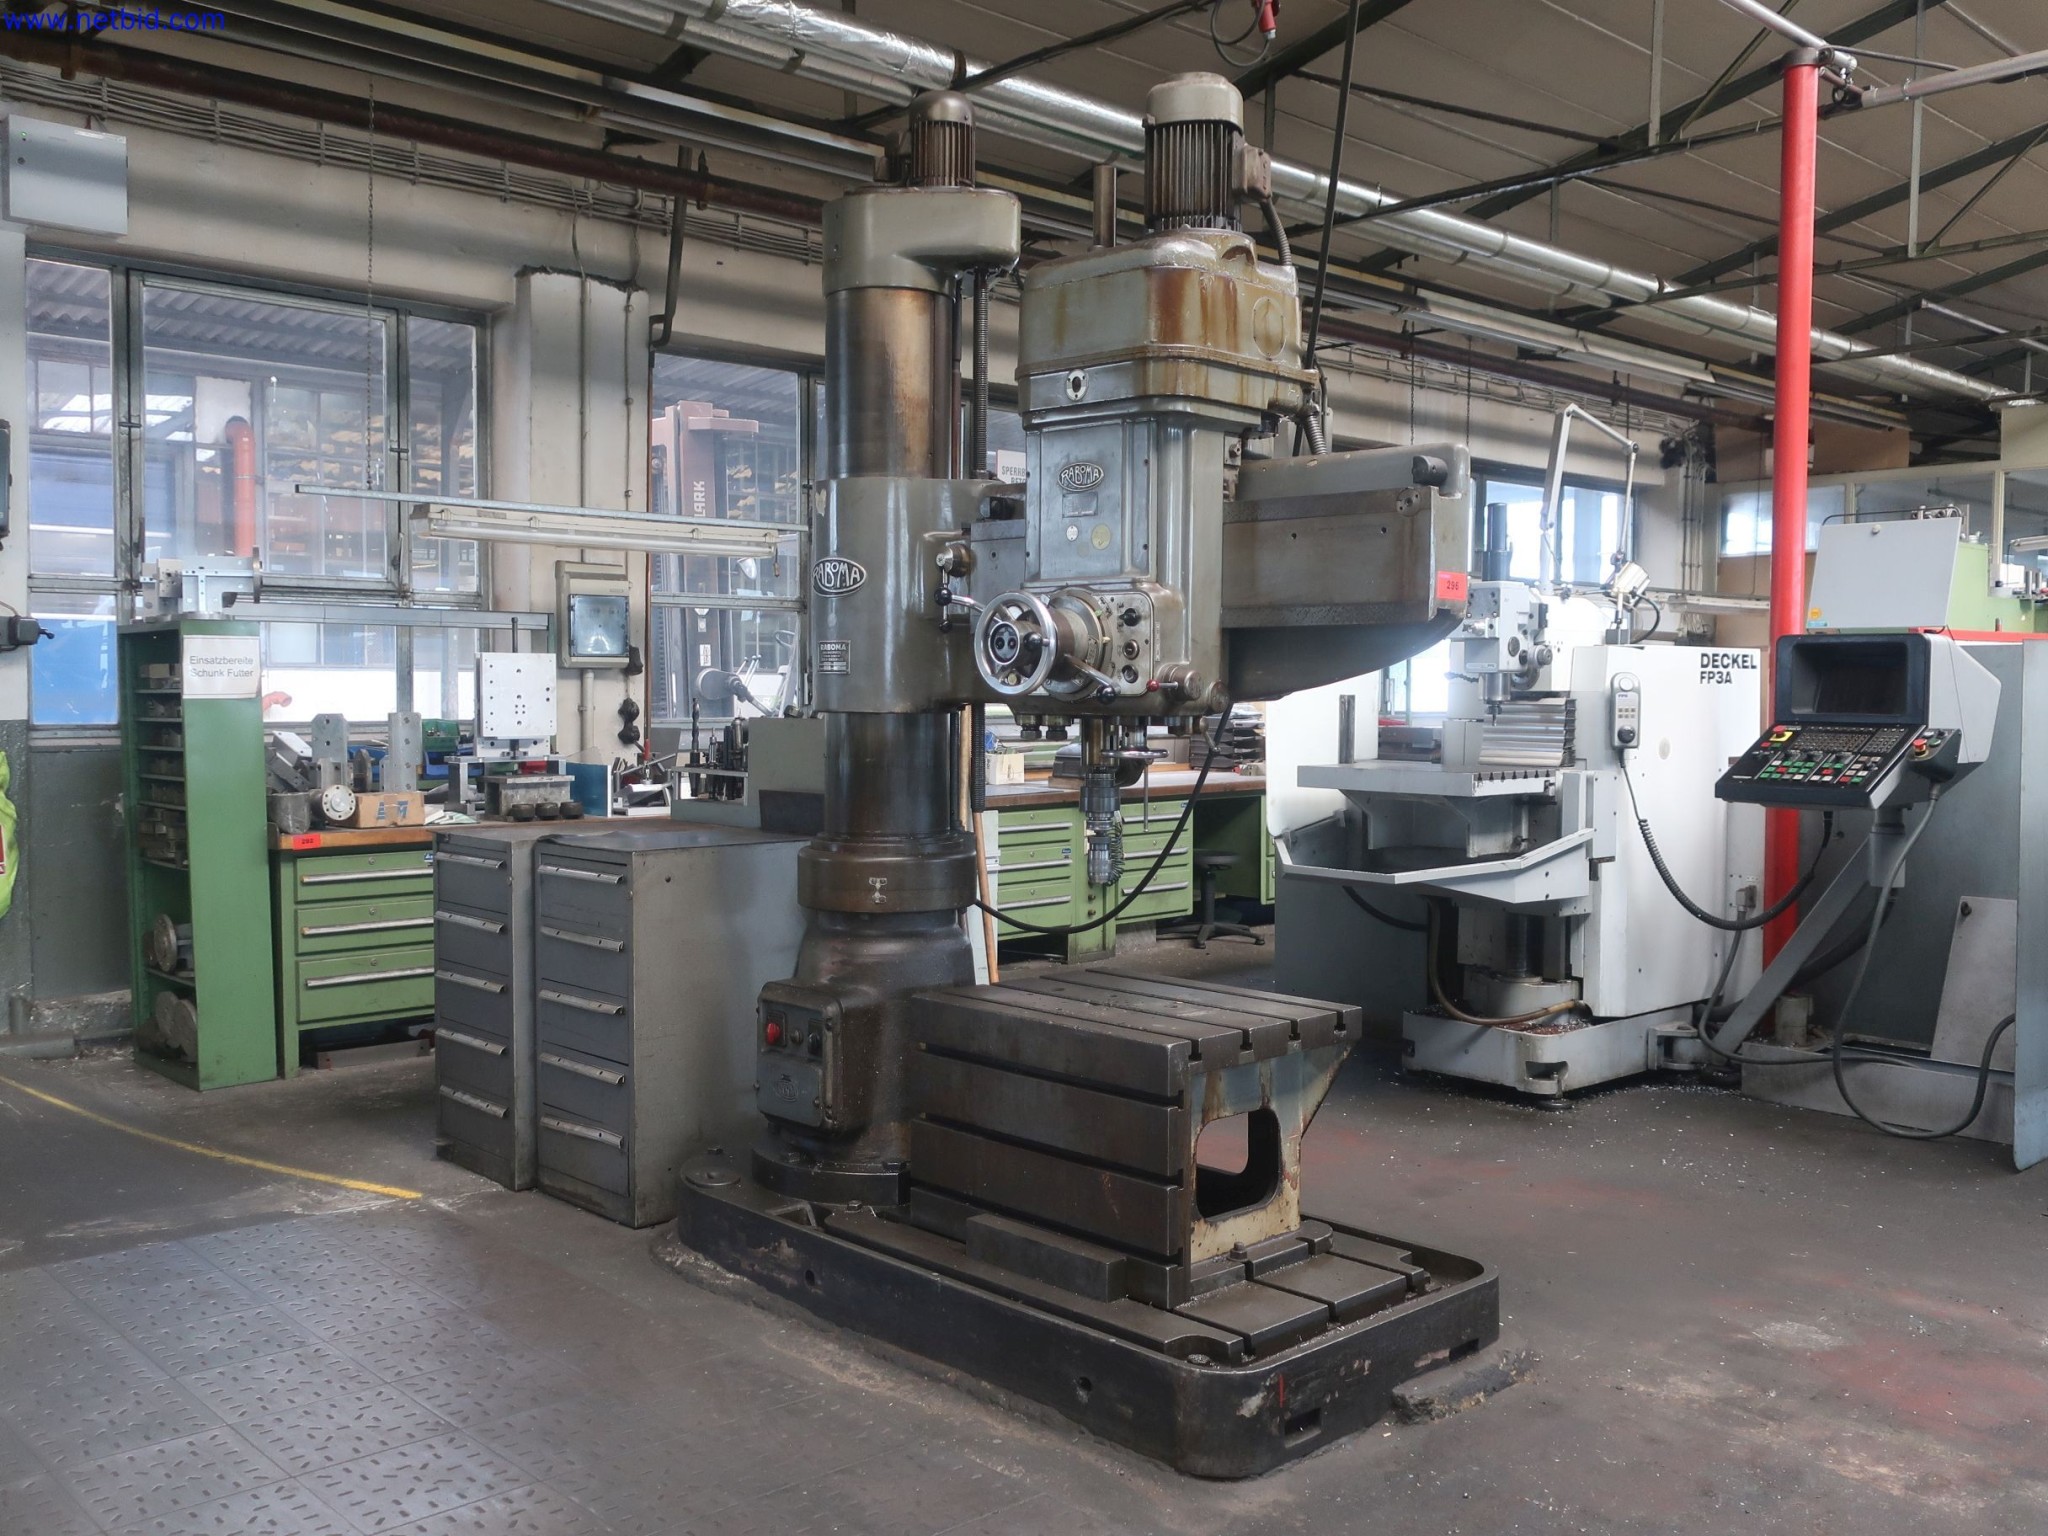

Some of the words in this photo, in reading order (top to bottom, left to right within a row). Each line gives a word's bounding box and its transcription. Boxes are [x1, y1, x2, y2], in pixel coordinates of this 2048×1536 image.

[1061, 465, 1100, 484] RABOMA
[693, 481, 706, 517] LARK
[812, 561, 861, 588] RABOMA
[1700, 653, 1758, 669] DECKEL
[190, 668, 225, 678] Schunk
[1700, 670, 1733, 684] FP3A
